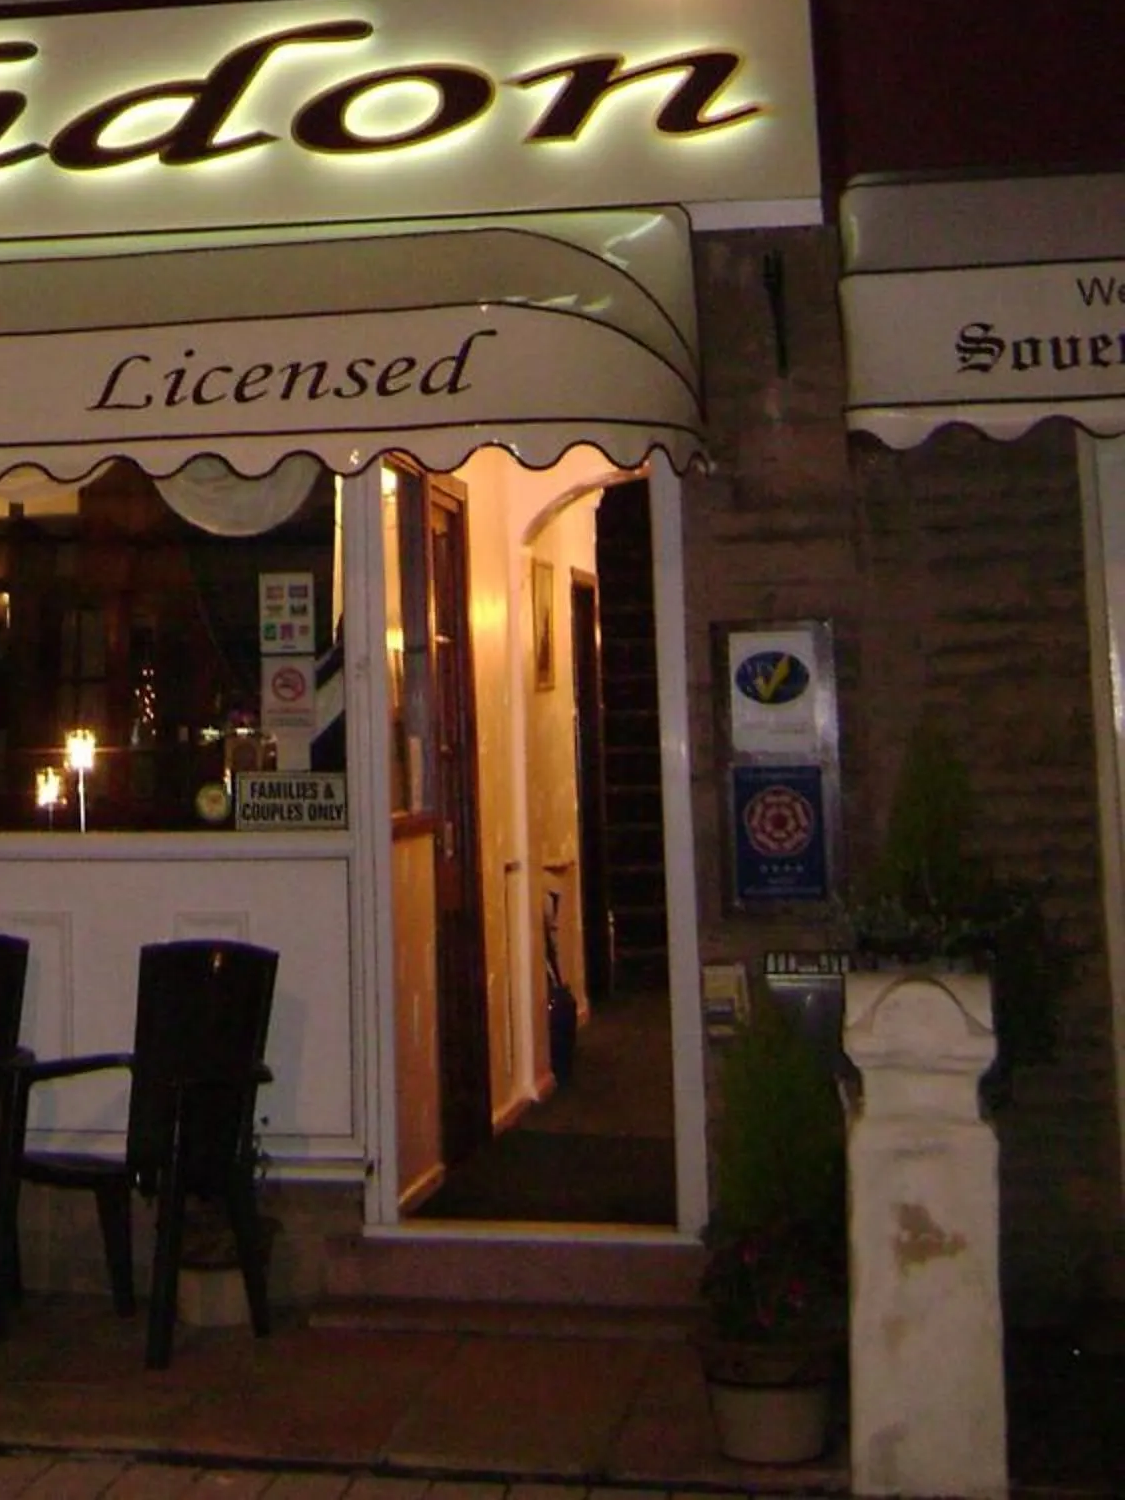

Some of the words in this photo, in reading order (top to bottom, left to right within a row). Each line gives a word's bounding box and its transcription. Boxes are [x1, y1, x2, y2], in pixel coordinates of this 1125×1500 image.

[87, 329, 496, 411] Licensed
[250, 781, 317, 799] FAMILIES
[242, 803, 303, 821] COUPLES
[308, 803, 343, 821] ONLY
